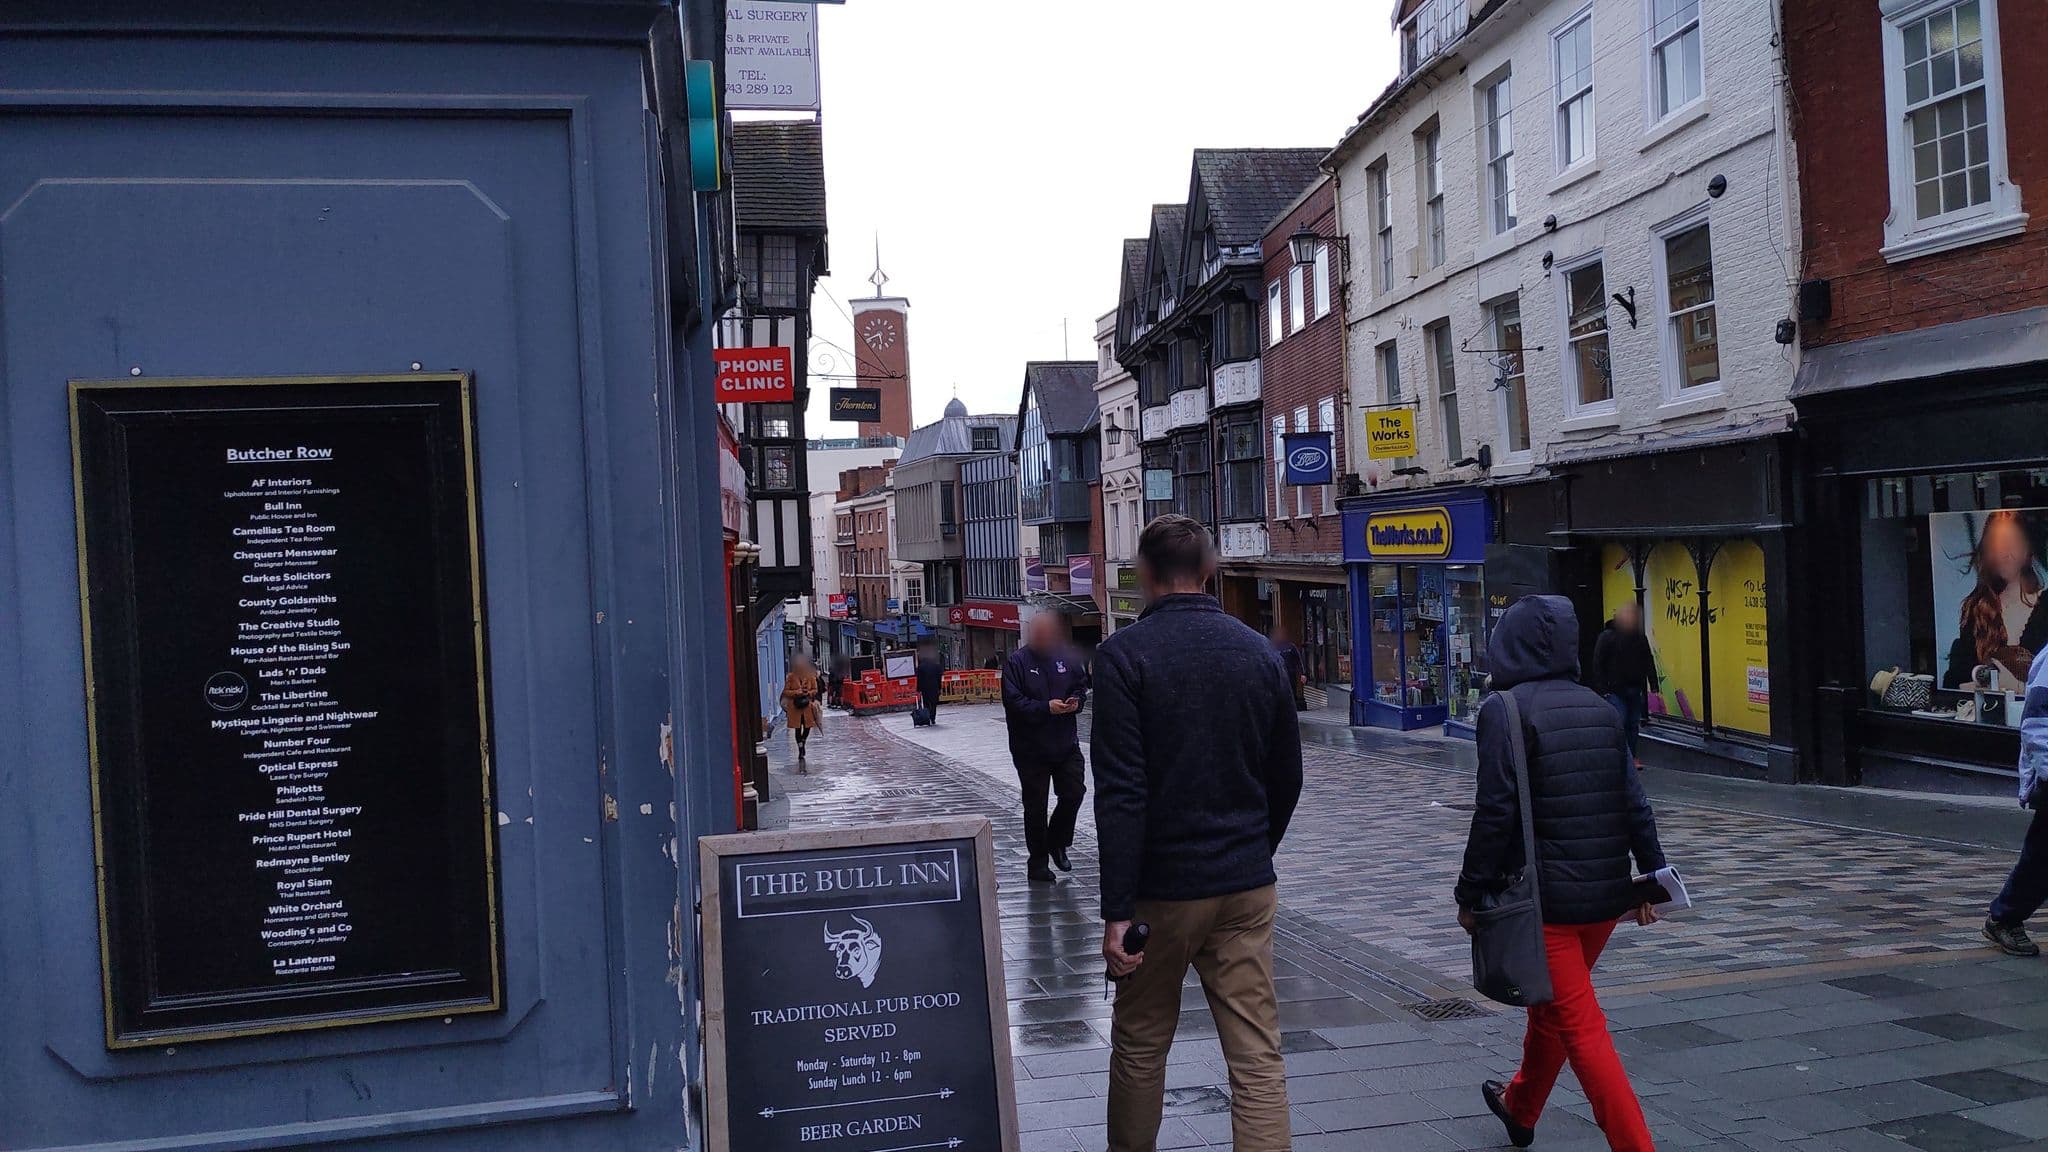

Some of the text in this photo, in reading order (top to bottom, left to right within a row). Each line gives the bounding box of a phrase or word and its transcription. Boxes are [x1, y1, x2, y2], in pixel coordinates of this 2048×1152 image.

[747, 9, 808, 21] SURGERY
[736, 34, 745, 43] &
[748, 34, 790, 44] PRIVATE
[758, 48, 812, 57] AVAILABLE
[738, 70, 766, 81] TEL:
[747, 84, 768, 94] 289
[773, 85, 793, 95] 123
[719, 359, 784, 373] PHONE
[721, 376, 786, 391] CLINIC
[835, 397, 877, 411] Thorntons
[1378, 417, 1401, 428] The
[1372, 428, 1410, 442] Works
[227, 446, 332, 460] Butcher Row
[1294, 452, 1320, 466] Boots
[251, 478, 312, 487] AF Interiors
[264, 502, 302, 511] Bull Inn
[232, 525, 335, 536] Camellias Tea Room
[1370, 522, 1443, 546] TheWorks.co.uk
[247, 537, 288, 545] Independent
[233, 549, 337, 560] Chequers Menswear
[242, 572, 331, 583] Clarkes Solicitors
[266, 584, 285, 592] Legal
[1666, 577, 1692, 600] JUST
[238, 595, 336, 608] County Goldsmiths
[238, 618, 339, 631] The Creative Studio
[230, 642, 350, 655] House of the Rising Sun
[259, 668, 283, 677] Lads
[300, 666, 326, 675] Dads
[260, 690, 328, 701] The Libertine
[251, 703, 278, 711] Cocktail
[211, 711, 378, 729] Mystique Lingerie and Nightwear
[270, 726, 304, 734] Nightwear
[264, 737, 330, 748] Number Four
[243, 751, 284, 759] Independent
[258, 761, 338, 774] Optical Express
[276, 784, 322, 795] Philpotts
[276, 796, 307, 804] Sandwich
[238, 806, 361, 821] Pride Hill Dental Surgery
[285, 819, 307, 827] Dental
[252, 828, 351, 844] Prince Rupert Hotel
[301, 841, 336, 849] Restaurant
[256, 853, 350, 868] Redmayne Bentley
[284, 866, 324, 874] Stockbroker
[277, 878, 332, 891] Royal Siam
[745, 861, 952, 896] THE BULL INN
[268, 900, 342, 914] White Orchard
[264, 916, 303, 924] Homewares
[261, 923, 352, 939] Wooding's and Co
[267, 935, 347, 947] Contemporary Jewellery
[273, 955, 335, 967] La Lanterna
[751, 992, 960, 1025] TRADITIONAL PUB FOOD
[824, 1023, 896, 1042] SERVED
[797, 1049, 920, 1073] Monday Saturday 12 8pm
[808, 1068, 911, 1090] Sunday Lunch 12 6pm
[800, 1114, 921, 1141] BEER GARDEN
